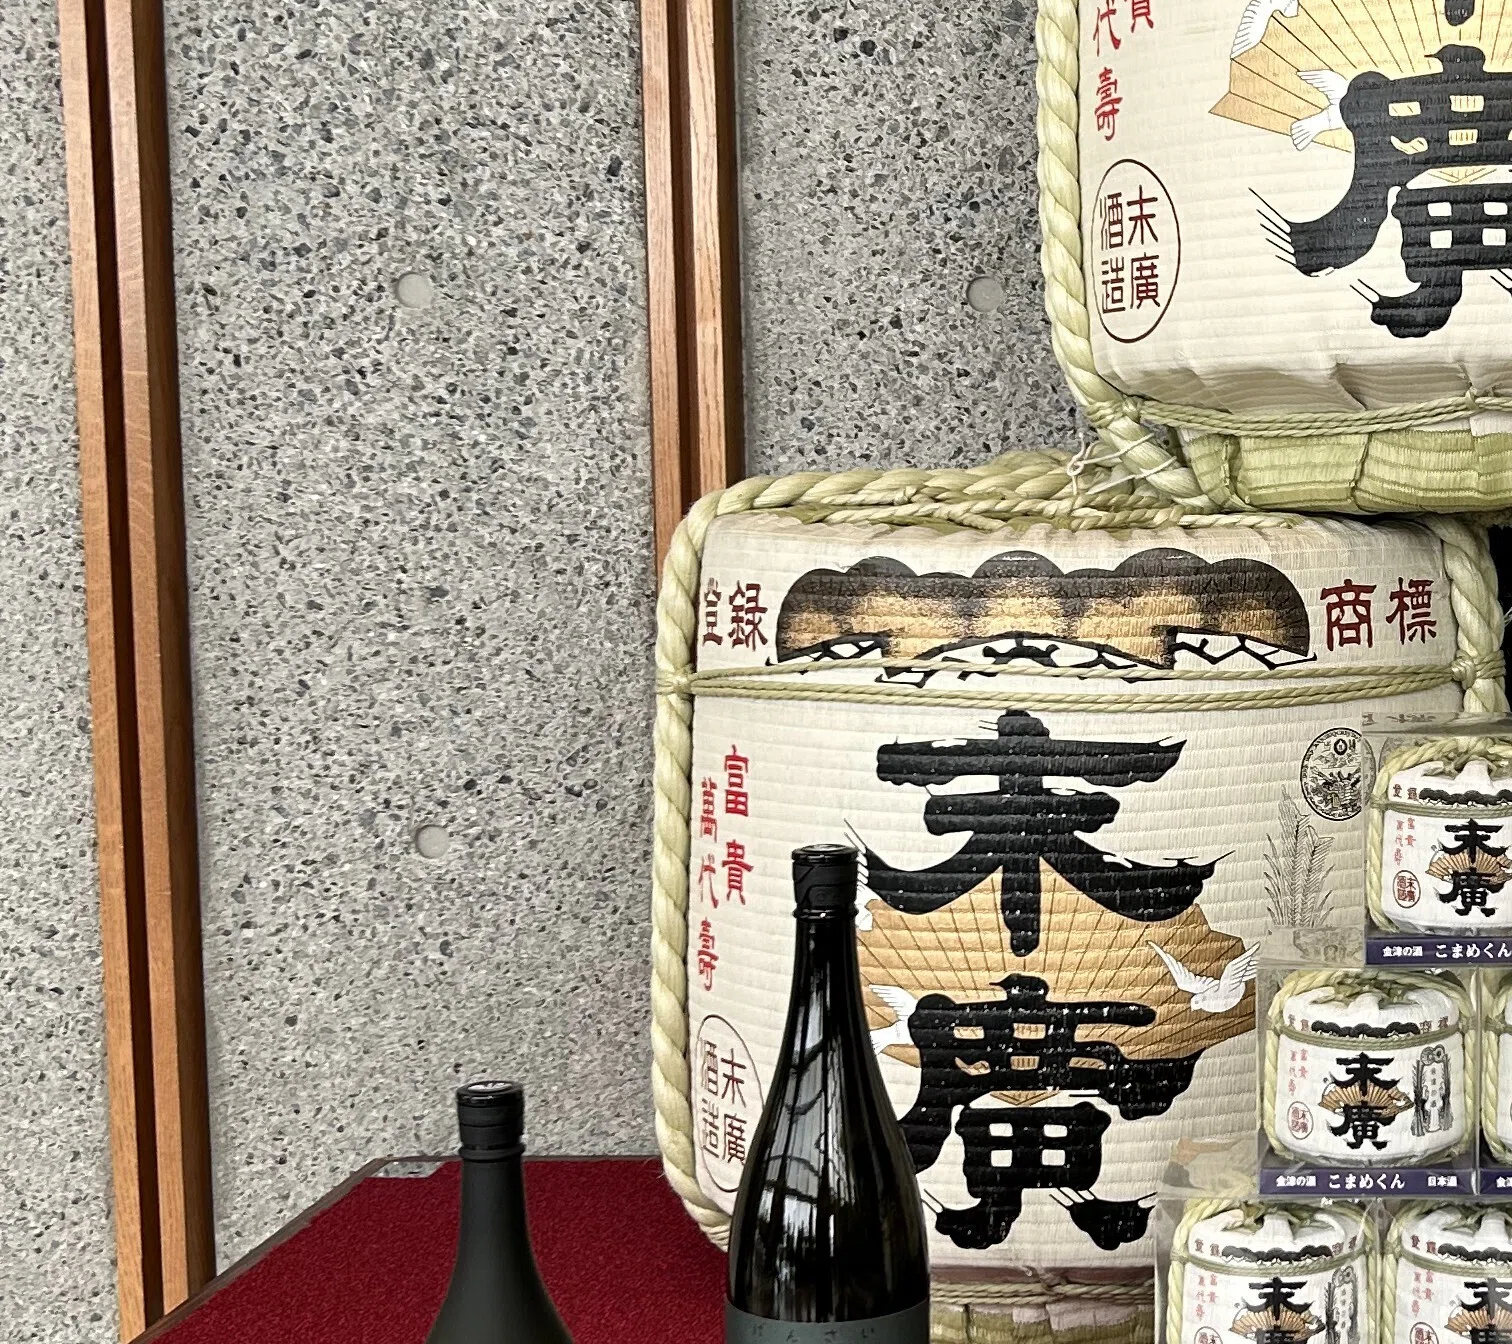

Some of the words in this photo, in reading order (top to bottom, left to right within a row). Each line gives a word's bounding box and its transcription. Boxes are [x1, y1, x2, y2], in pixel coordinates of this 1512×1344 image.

[1318, 578, 1438, 652] 商標
[721, 744, 754, 905] 富貴
[1435, 942, 1512, 959] こまめくん
[1328, 1173, 1406, 1190] こまめくん
